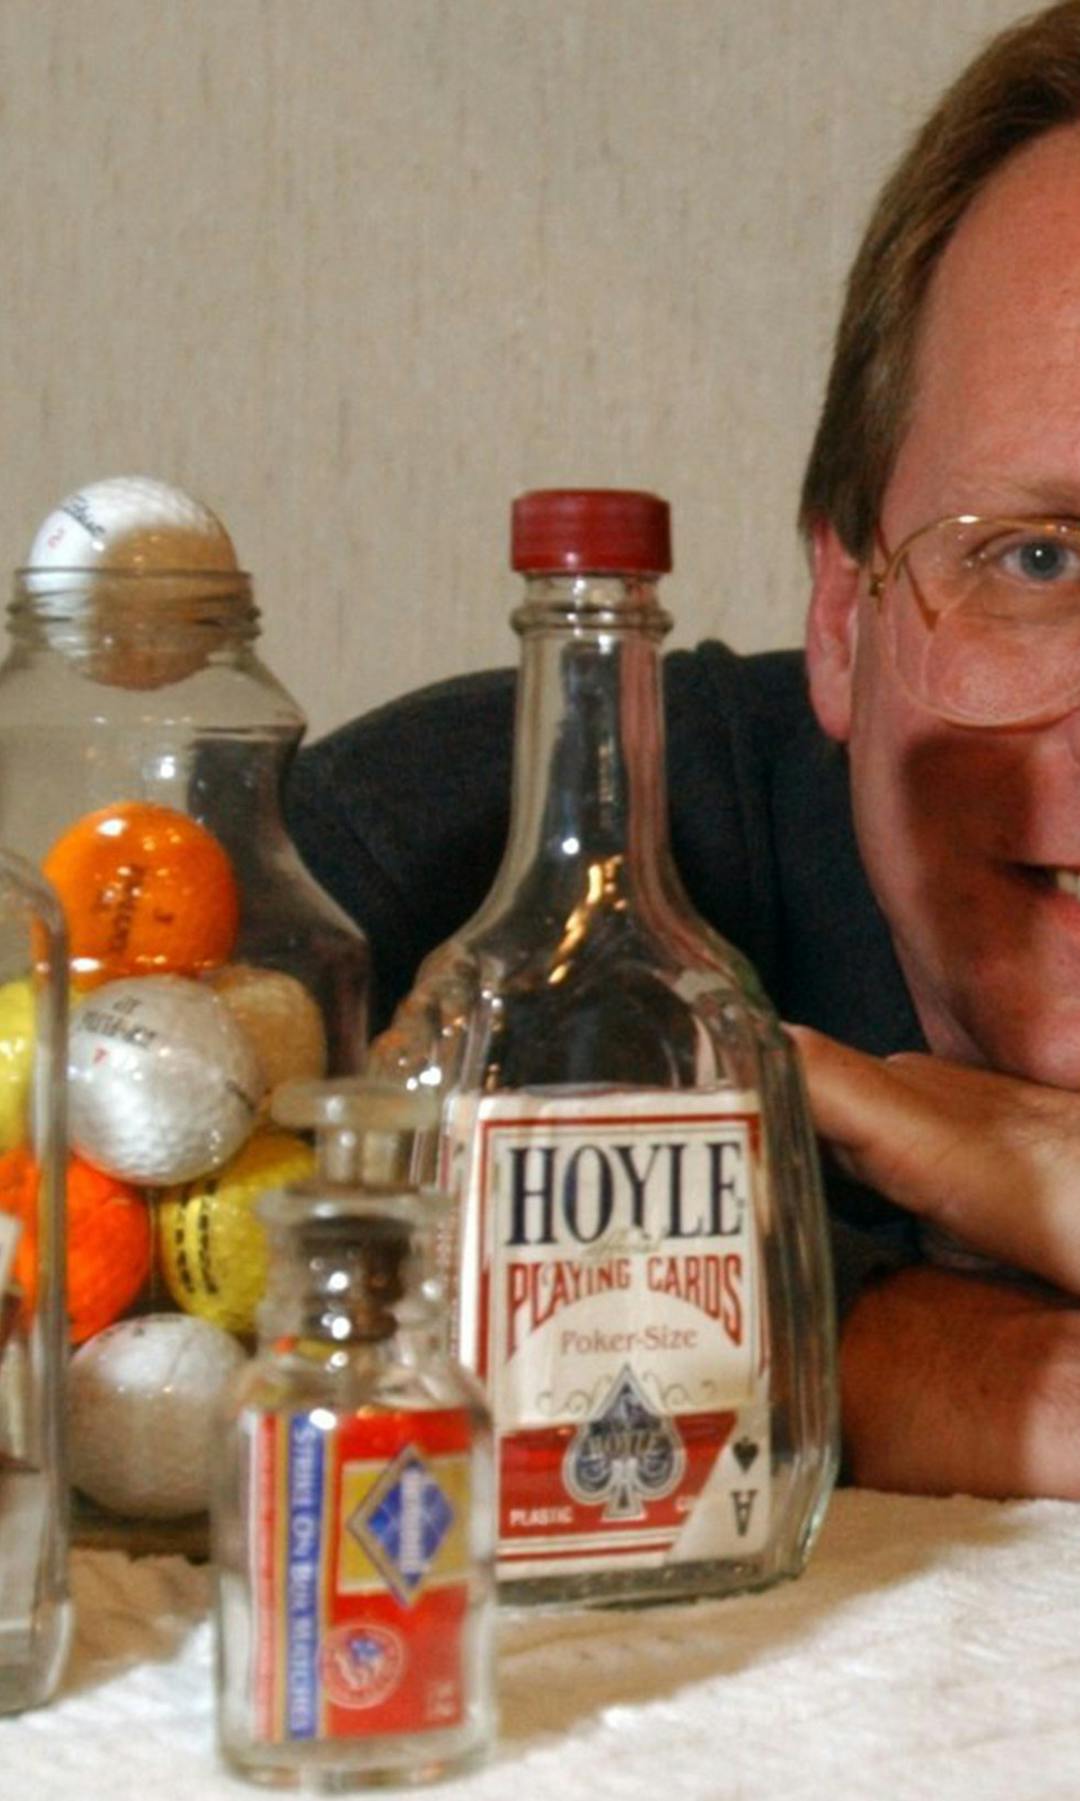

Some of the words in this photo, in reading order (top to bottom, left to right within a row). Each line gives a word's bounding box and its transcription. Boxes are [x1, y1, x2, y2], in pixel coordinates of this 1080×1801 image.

[507, 1142, 742, 1245] HOYLE
[507, 1260, 631, 1362] PLAYING
[647, 1254, 743, 1347] CARDS
[561, 1325, 698, 1355] Poker-Size
[510, 1506, 573, 1526] PLASTIC
